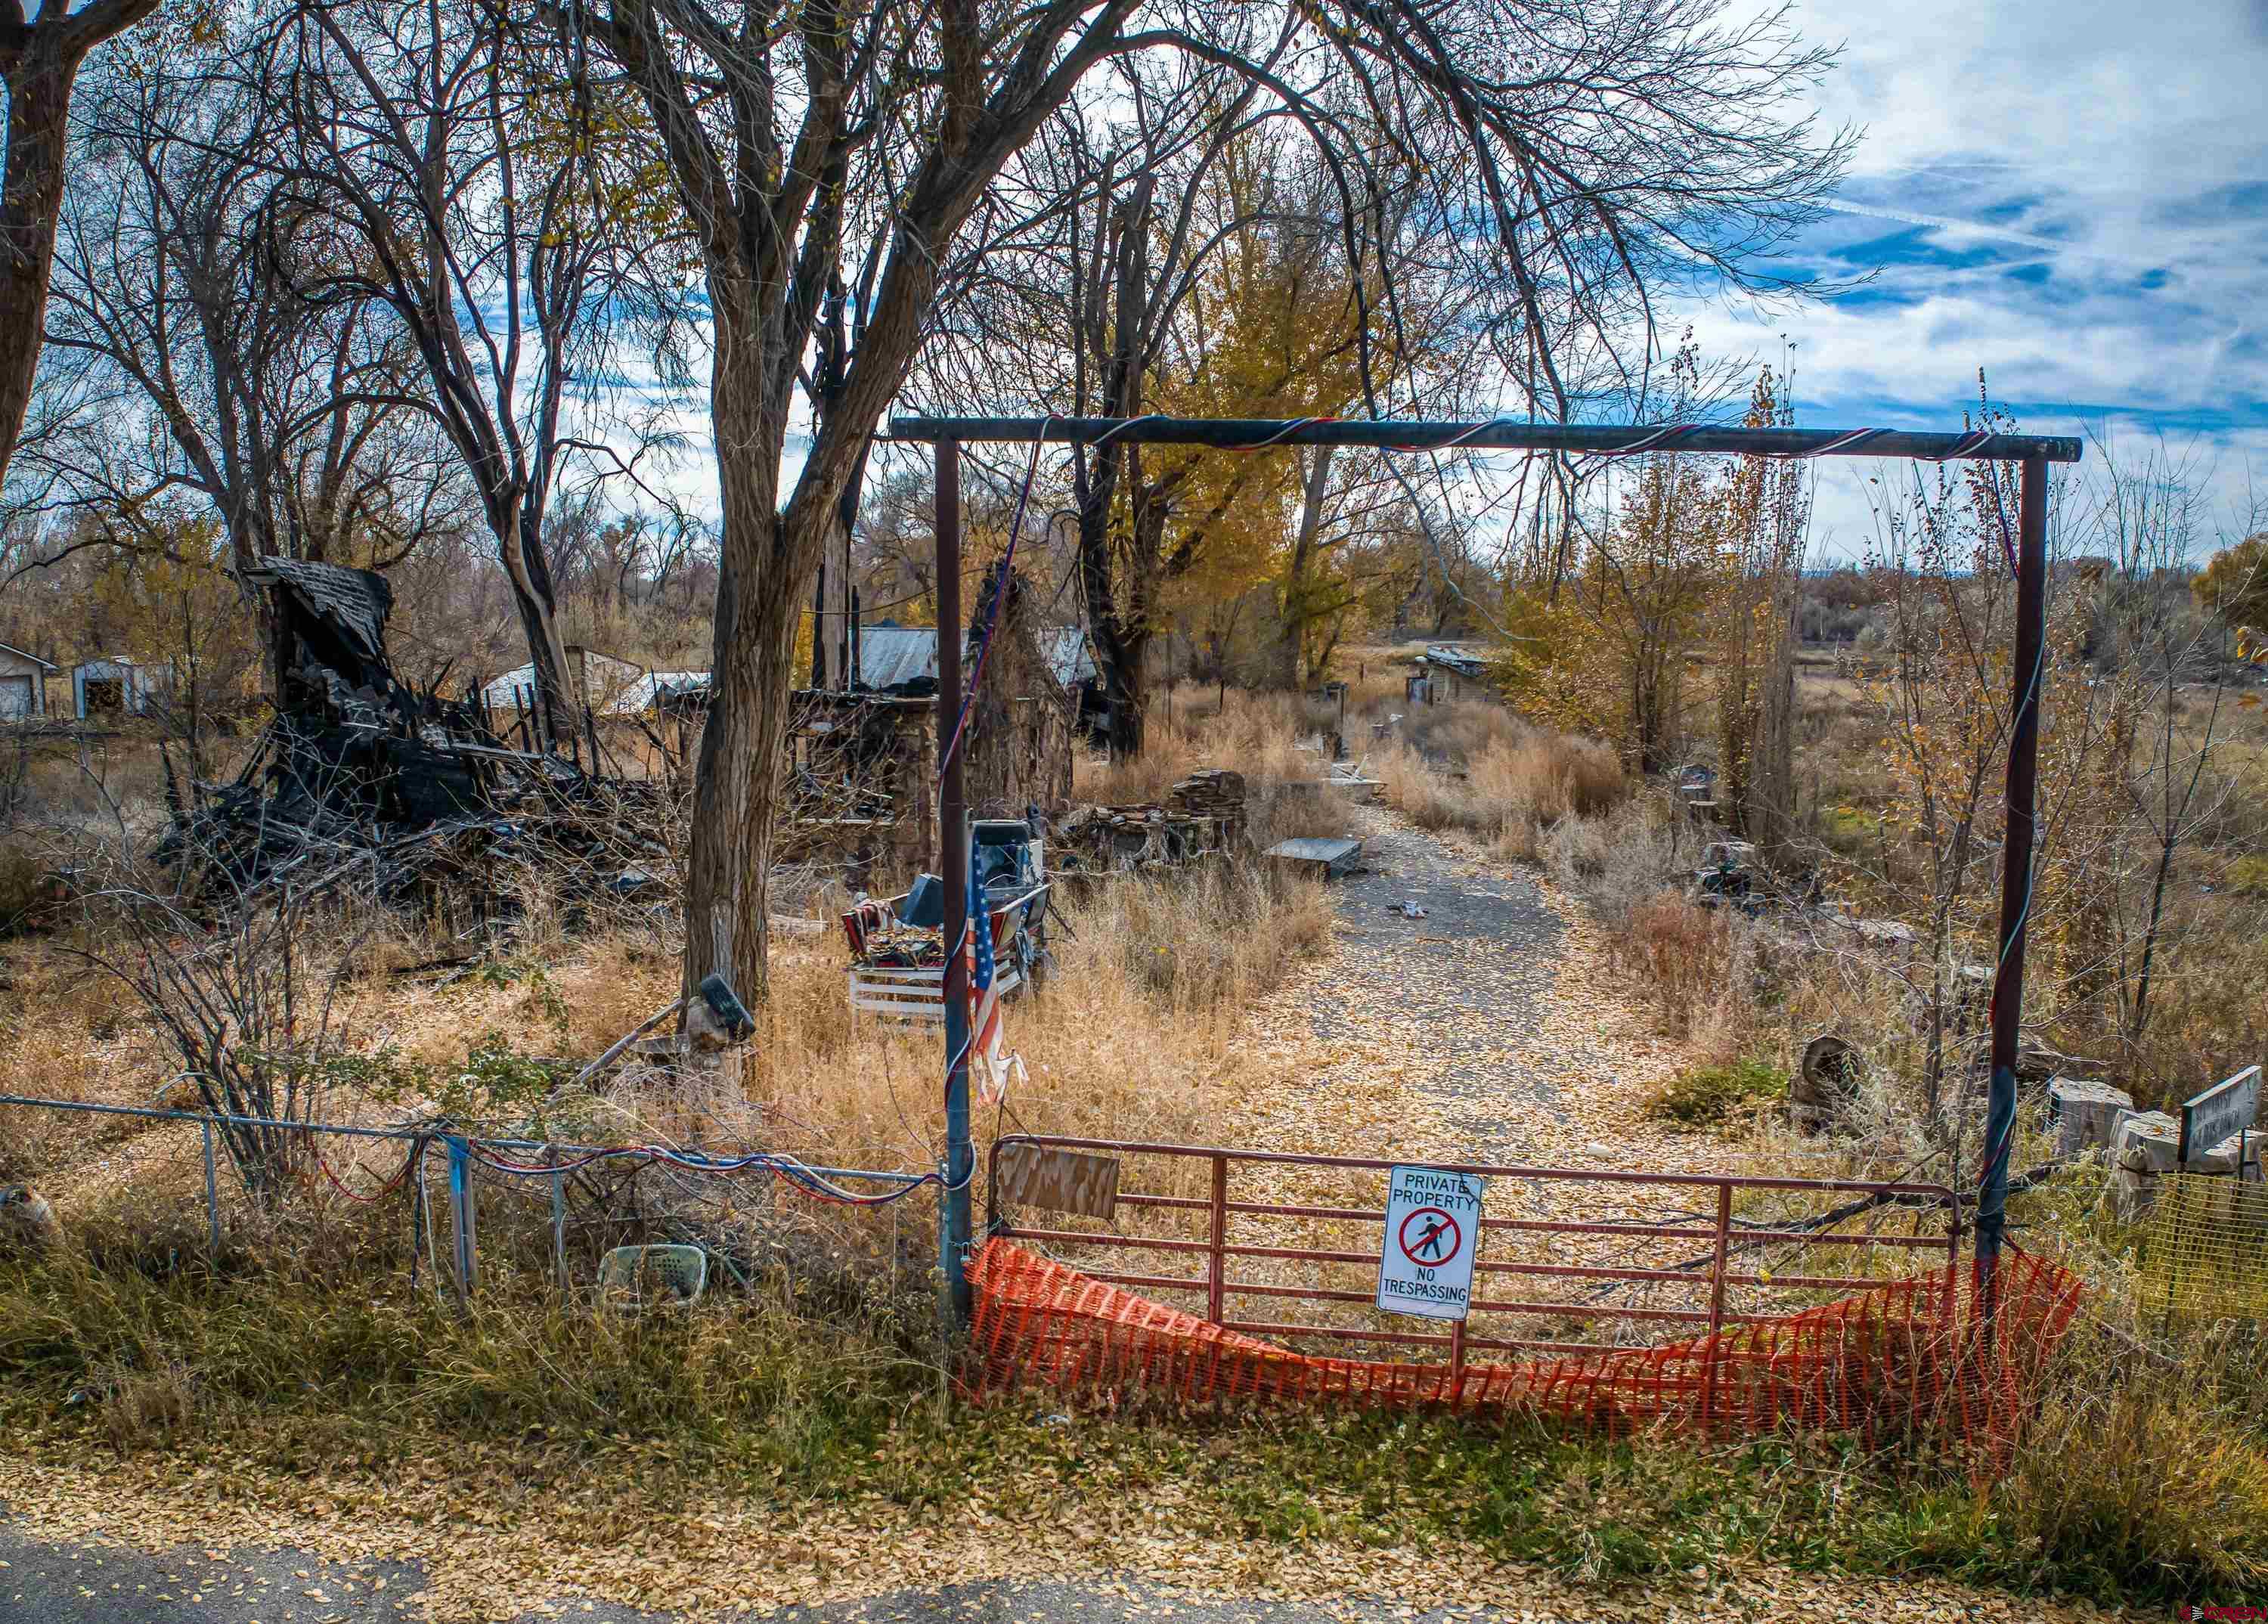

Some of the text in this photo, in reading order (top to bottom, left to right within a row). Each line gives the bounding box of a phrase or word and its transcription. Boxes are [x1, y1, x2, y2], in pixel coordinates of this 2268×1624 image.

[1405, 1173, 1468, 1194] PRIVATE
[1393, 1189, 1476, 1210] PROPERTY
[1417, 1267, 1435, 1282] NO
[1384, 1278, 1467, 1301] TRESPASSING
